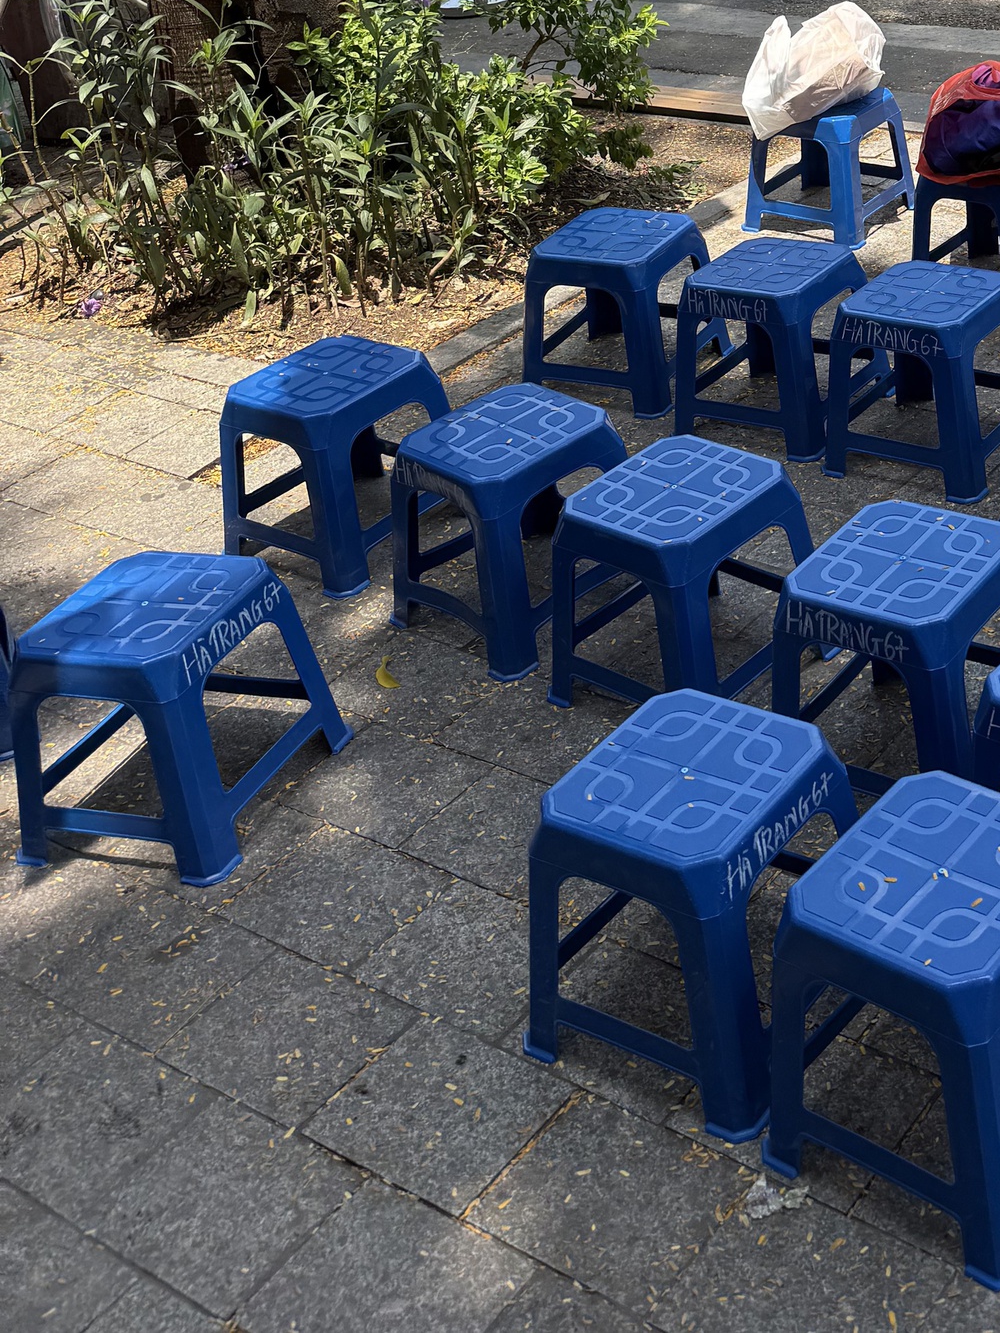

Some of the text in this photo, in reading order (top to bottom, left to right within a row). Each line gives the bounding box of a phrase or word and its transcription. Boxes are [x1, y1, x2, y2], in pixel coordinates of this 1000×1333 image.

[704, 288, 753, 321] TRANG
[754, 298, 769, 323] 67
[841, 317, 944, 357] HÀ TRANG 67
[182, 581, 282, 687] HÀ TRANG 67
[786, 599, 910, 663] HÀ TRANG 67
[726, 771, 834, 902] HÀ TRANG 67
